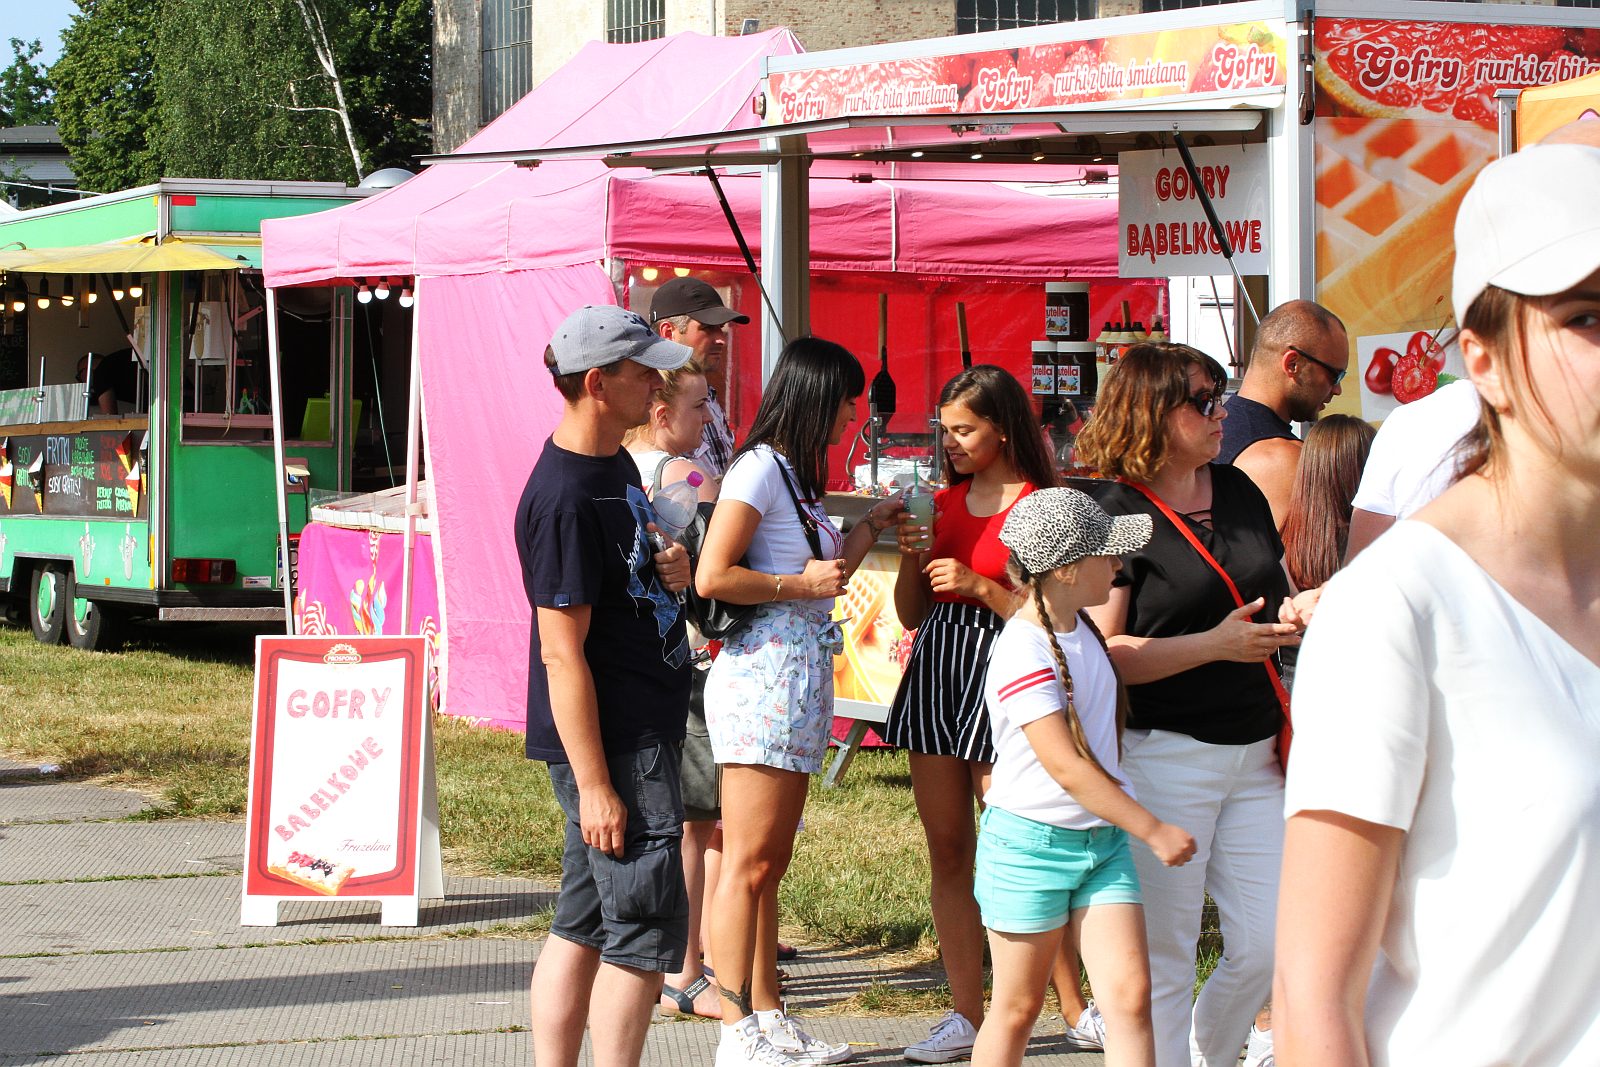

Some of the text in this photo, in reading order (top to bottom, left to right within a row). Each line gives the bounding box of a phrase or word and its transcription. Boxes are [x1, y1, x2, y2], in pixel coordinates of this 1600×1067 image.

[1356, 44, 1462, 90] Gofry
[1477, 56, 1536, 82] rurki
[1540, 64, 1553, 83] z
[781, 91, 825, 124] Gofry
[874, 94, 880, 111] z
[979, 70, 1032, 109] Gofry
[1054, 66, 1089, 94] rurki
[1090, 70, 1097, 92] z
[1100, 64, 1124, 93] bitą
[1127, 59, 1186, 89] śmietaną
[1214, 46, 1275, 89] Gofry
[1127, 219, 1262, 264] BĄBELKOWE
[1046, 306, 1068, 317] utella
[1032, 365, 1053, 376] utella
[1058, 365, 1079, 376] utella
[46, 436, 70, 466] FRYTKI
[48, 476, 61, 493] SOSY
[286, 686, 392, 720] GOFRY
